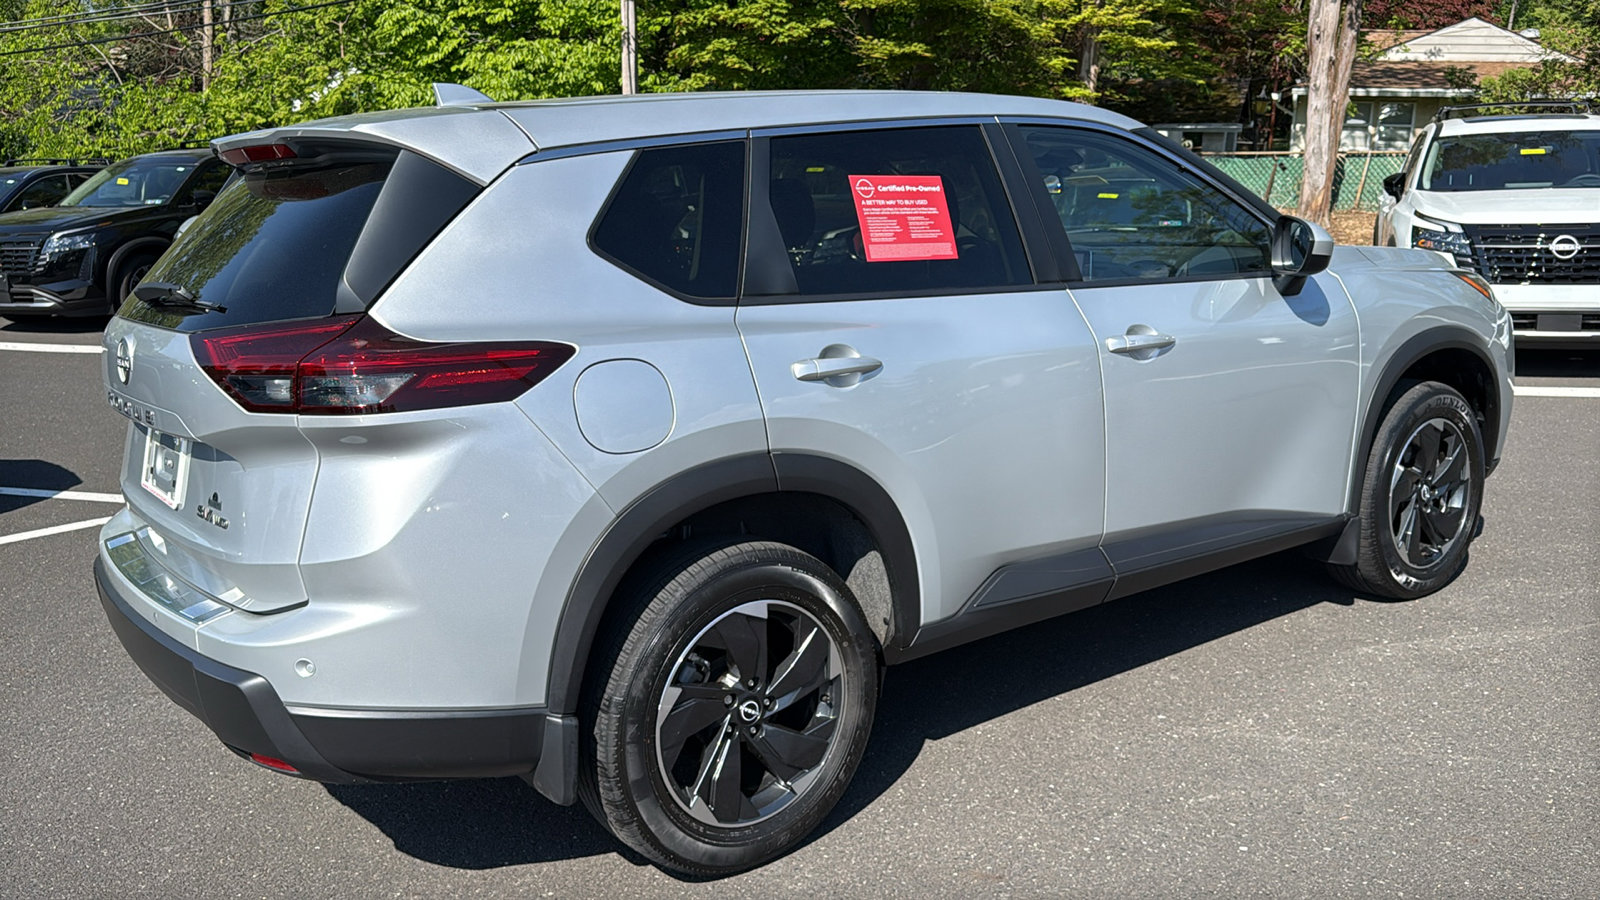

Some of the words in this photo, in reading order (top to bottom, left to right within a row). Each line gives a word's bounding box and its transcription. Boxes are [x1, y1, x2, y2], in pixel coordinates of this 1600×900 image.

[878, 184, 905, 192] Certified
[905, 184, 941, 192] Pre-Owned
[1549, 243, 1581, 251] NISSAN
[1435, 396, 1472, 418] DUNLOP
